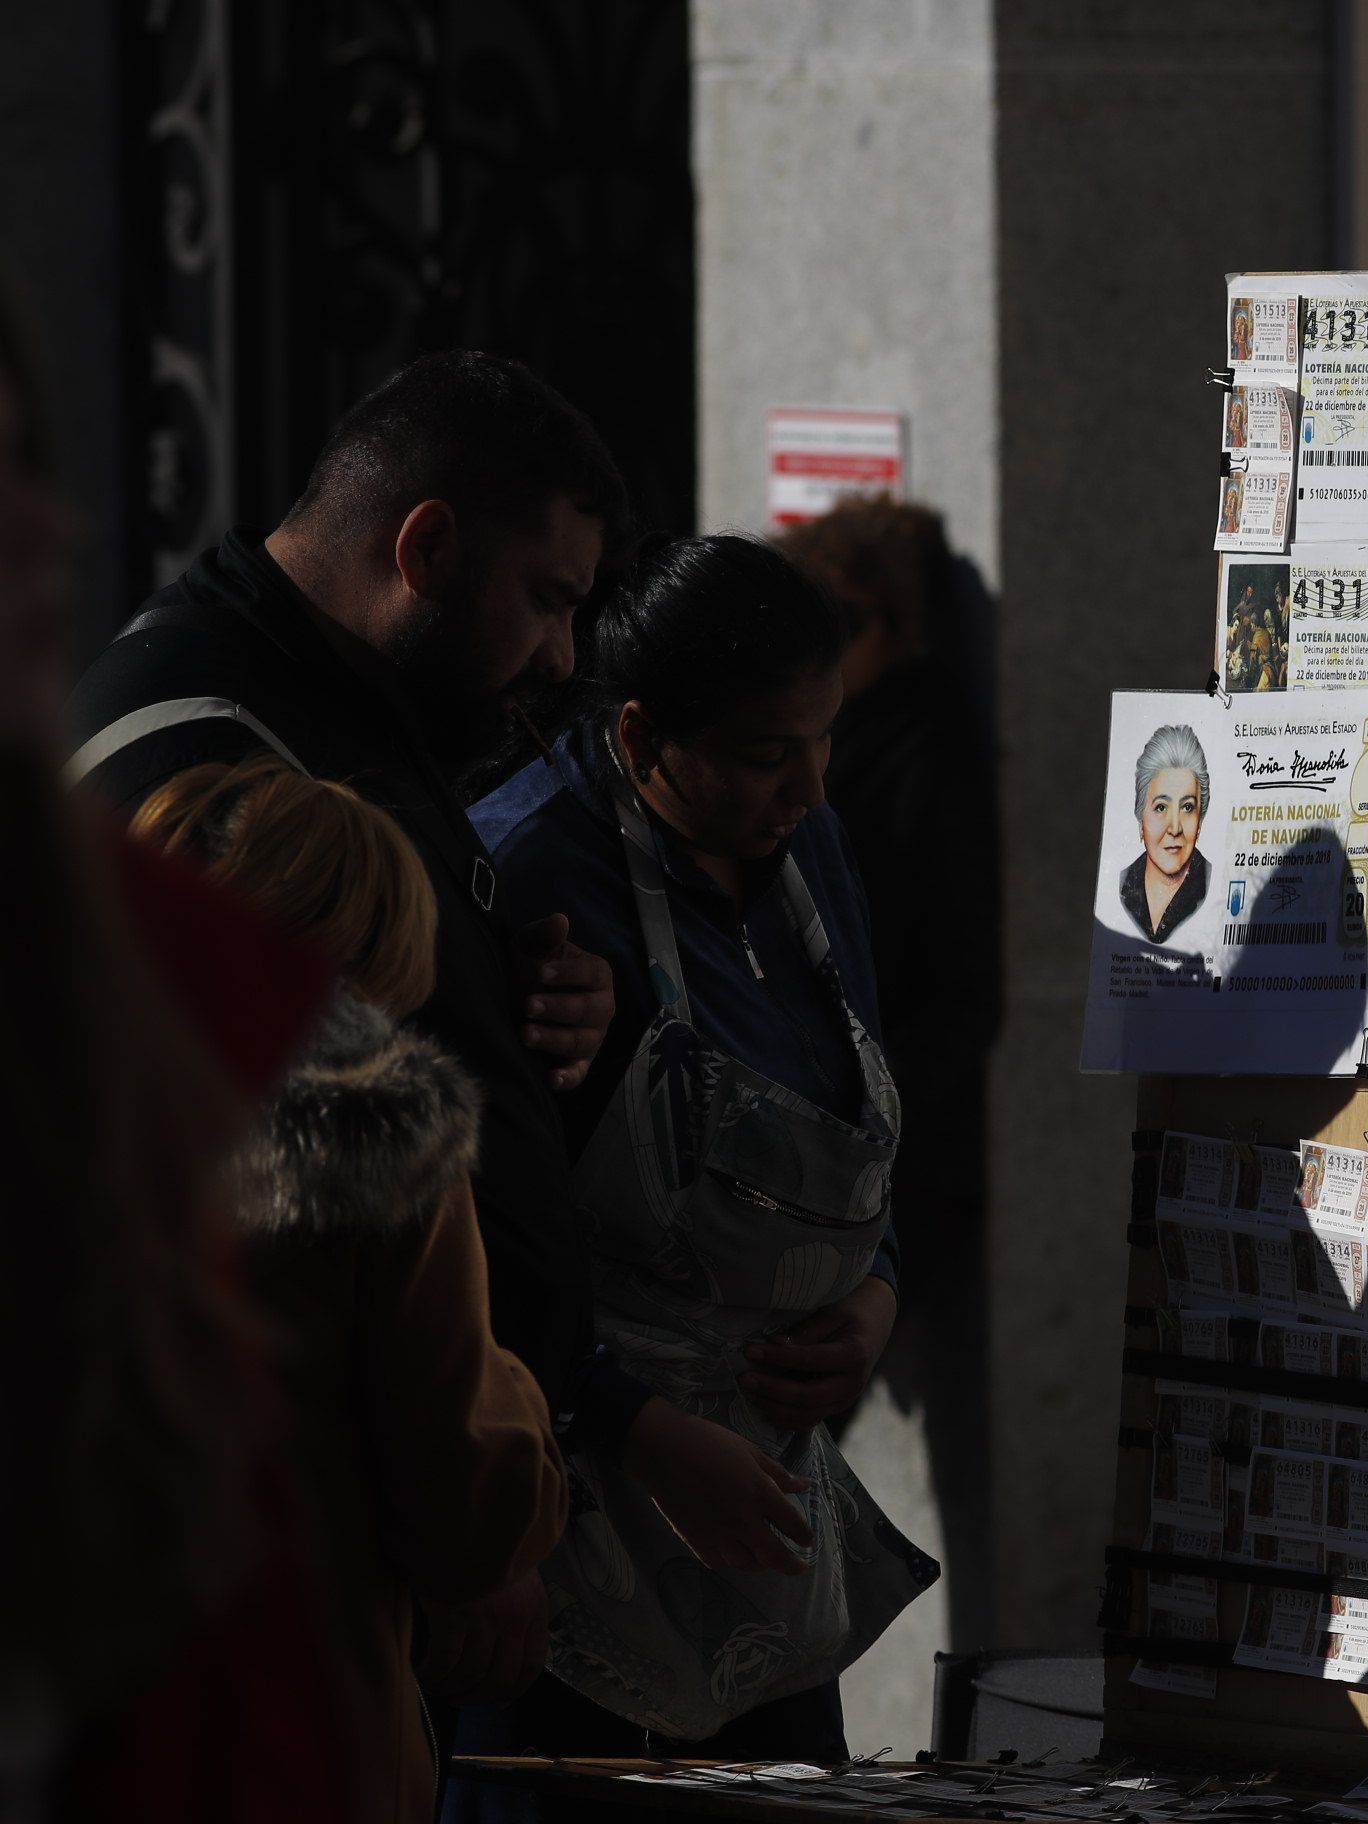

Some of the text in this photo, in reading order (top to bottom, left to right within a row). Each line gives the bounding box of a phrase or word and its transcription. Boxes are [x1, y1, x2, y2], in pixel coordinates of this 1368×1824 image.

[1255, 304, 1286, 317] 91513
[1305, 363, 1342, 373] LOTERÍA
[1306, 401, 1313, 411] 22
[1315, 401, 1323, 410] de
[1324, 401, 1355, 411] diciembre
[1357, 402, 1365, 410] de
[1246, 478, 1277, 490] 41313
[1232, 801, 1341, 821] LOTERÍA NACIONAL
[1251, 828, 1322, 844] DE NAVIDAD
[1347, 846, 1368, 855] FRACCIÓN
[1235, 851, 1331, 866] 22 de diciembre de 2018
[1327, 1155, 1363, 1173] 41314
